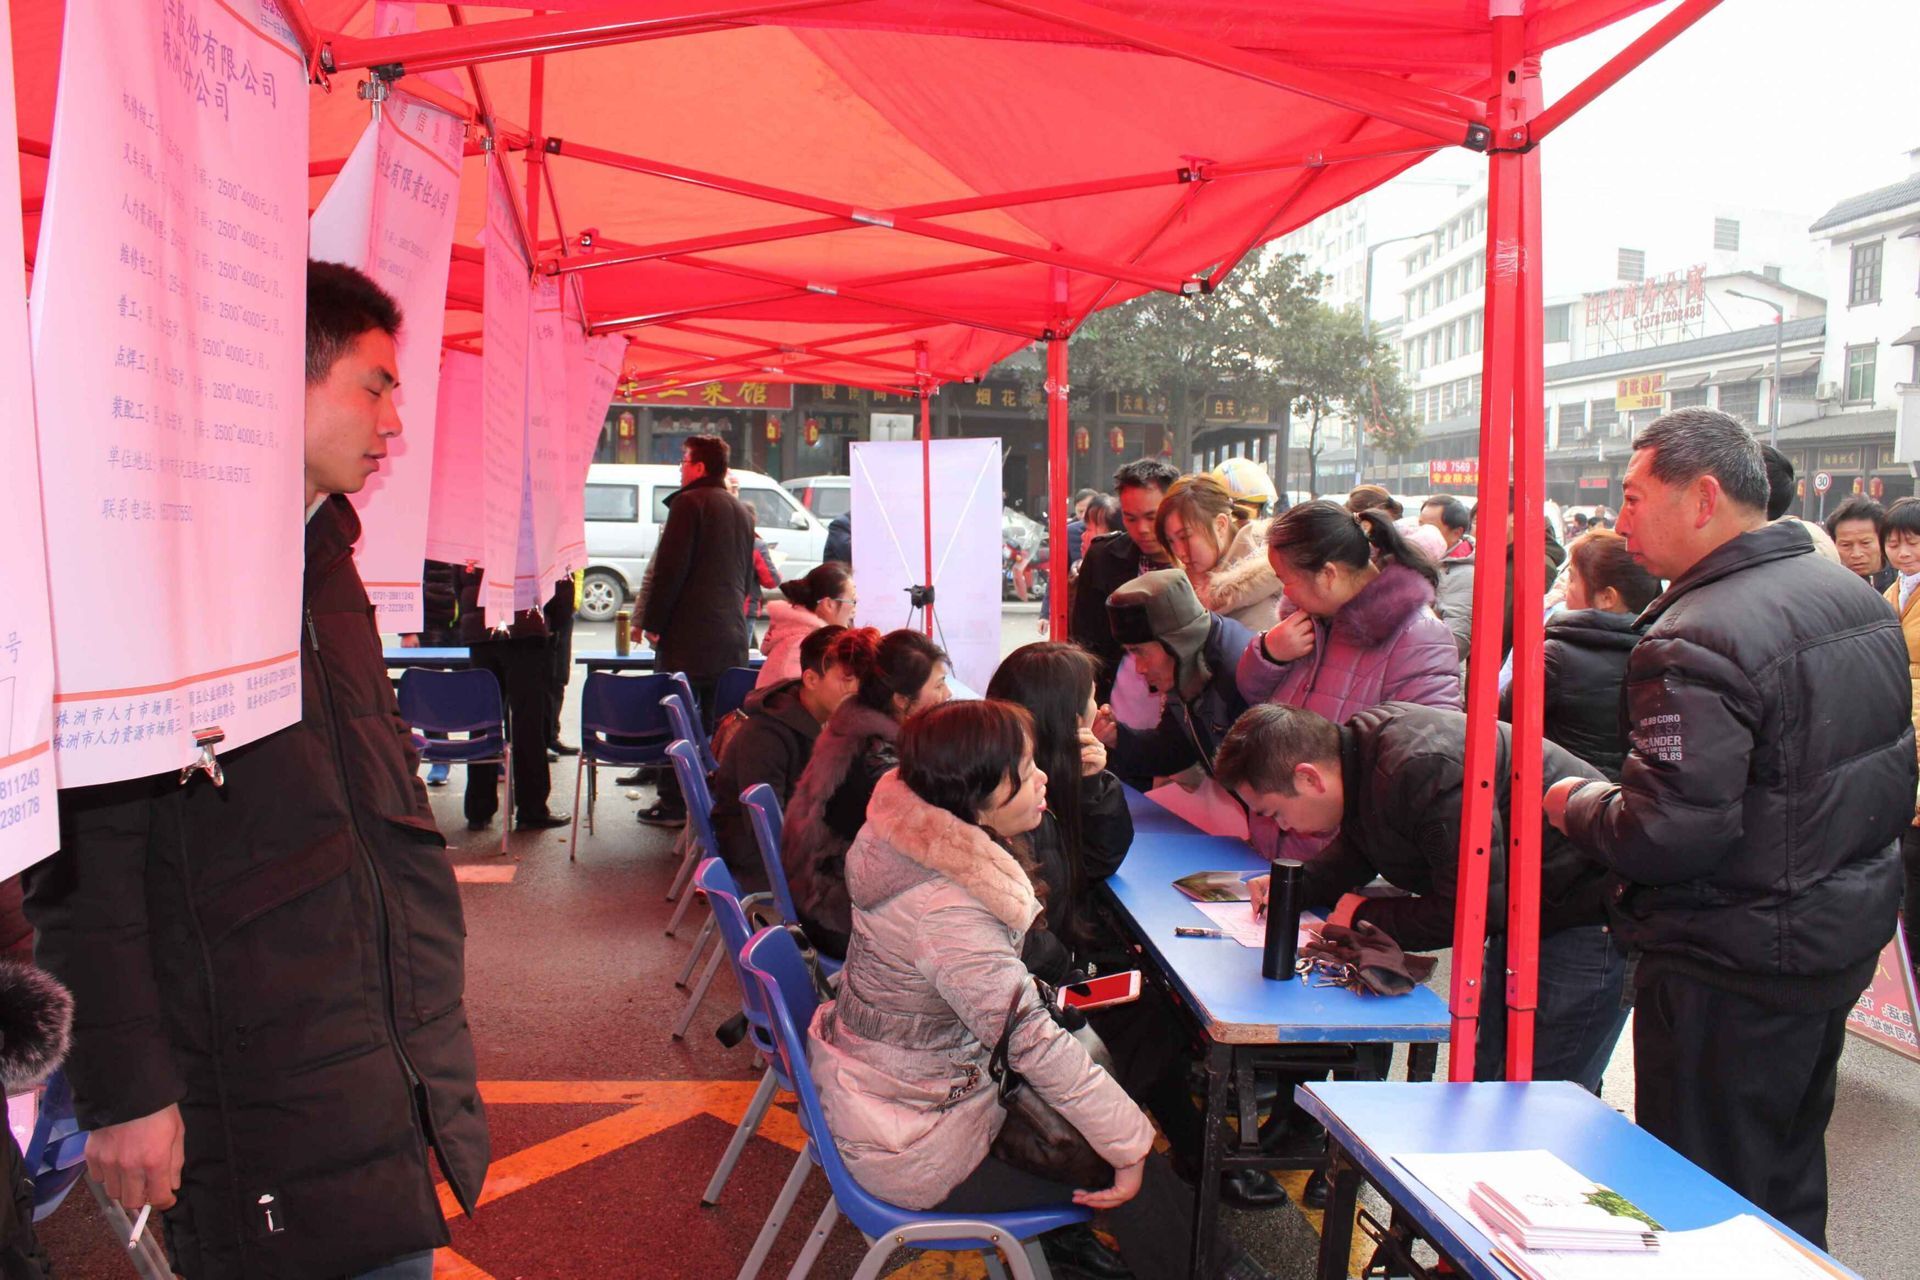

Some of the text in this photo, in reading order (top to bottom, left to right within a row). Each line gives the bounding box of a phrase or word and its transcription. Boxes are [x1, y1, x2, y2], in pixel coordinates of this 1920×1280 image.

[1817, 476, 1828, 487] 30
[1657, 714, 1680, 724] CORO
[1659, 752, 1683, 761] 19.89
